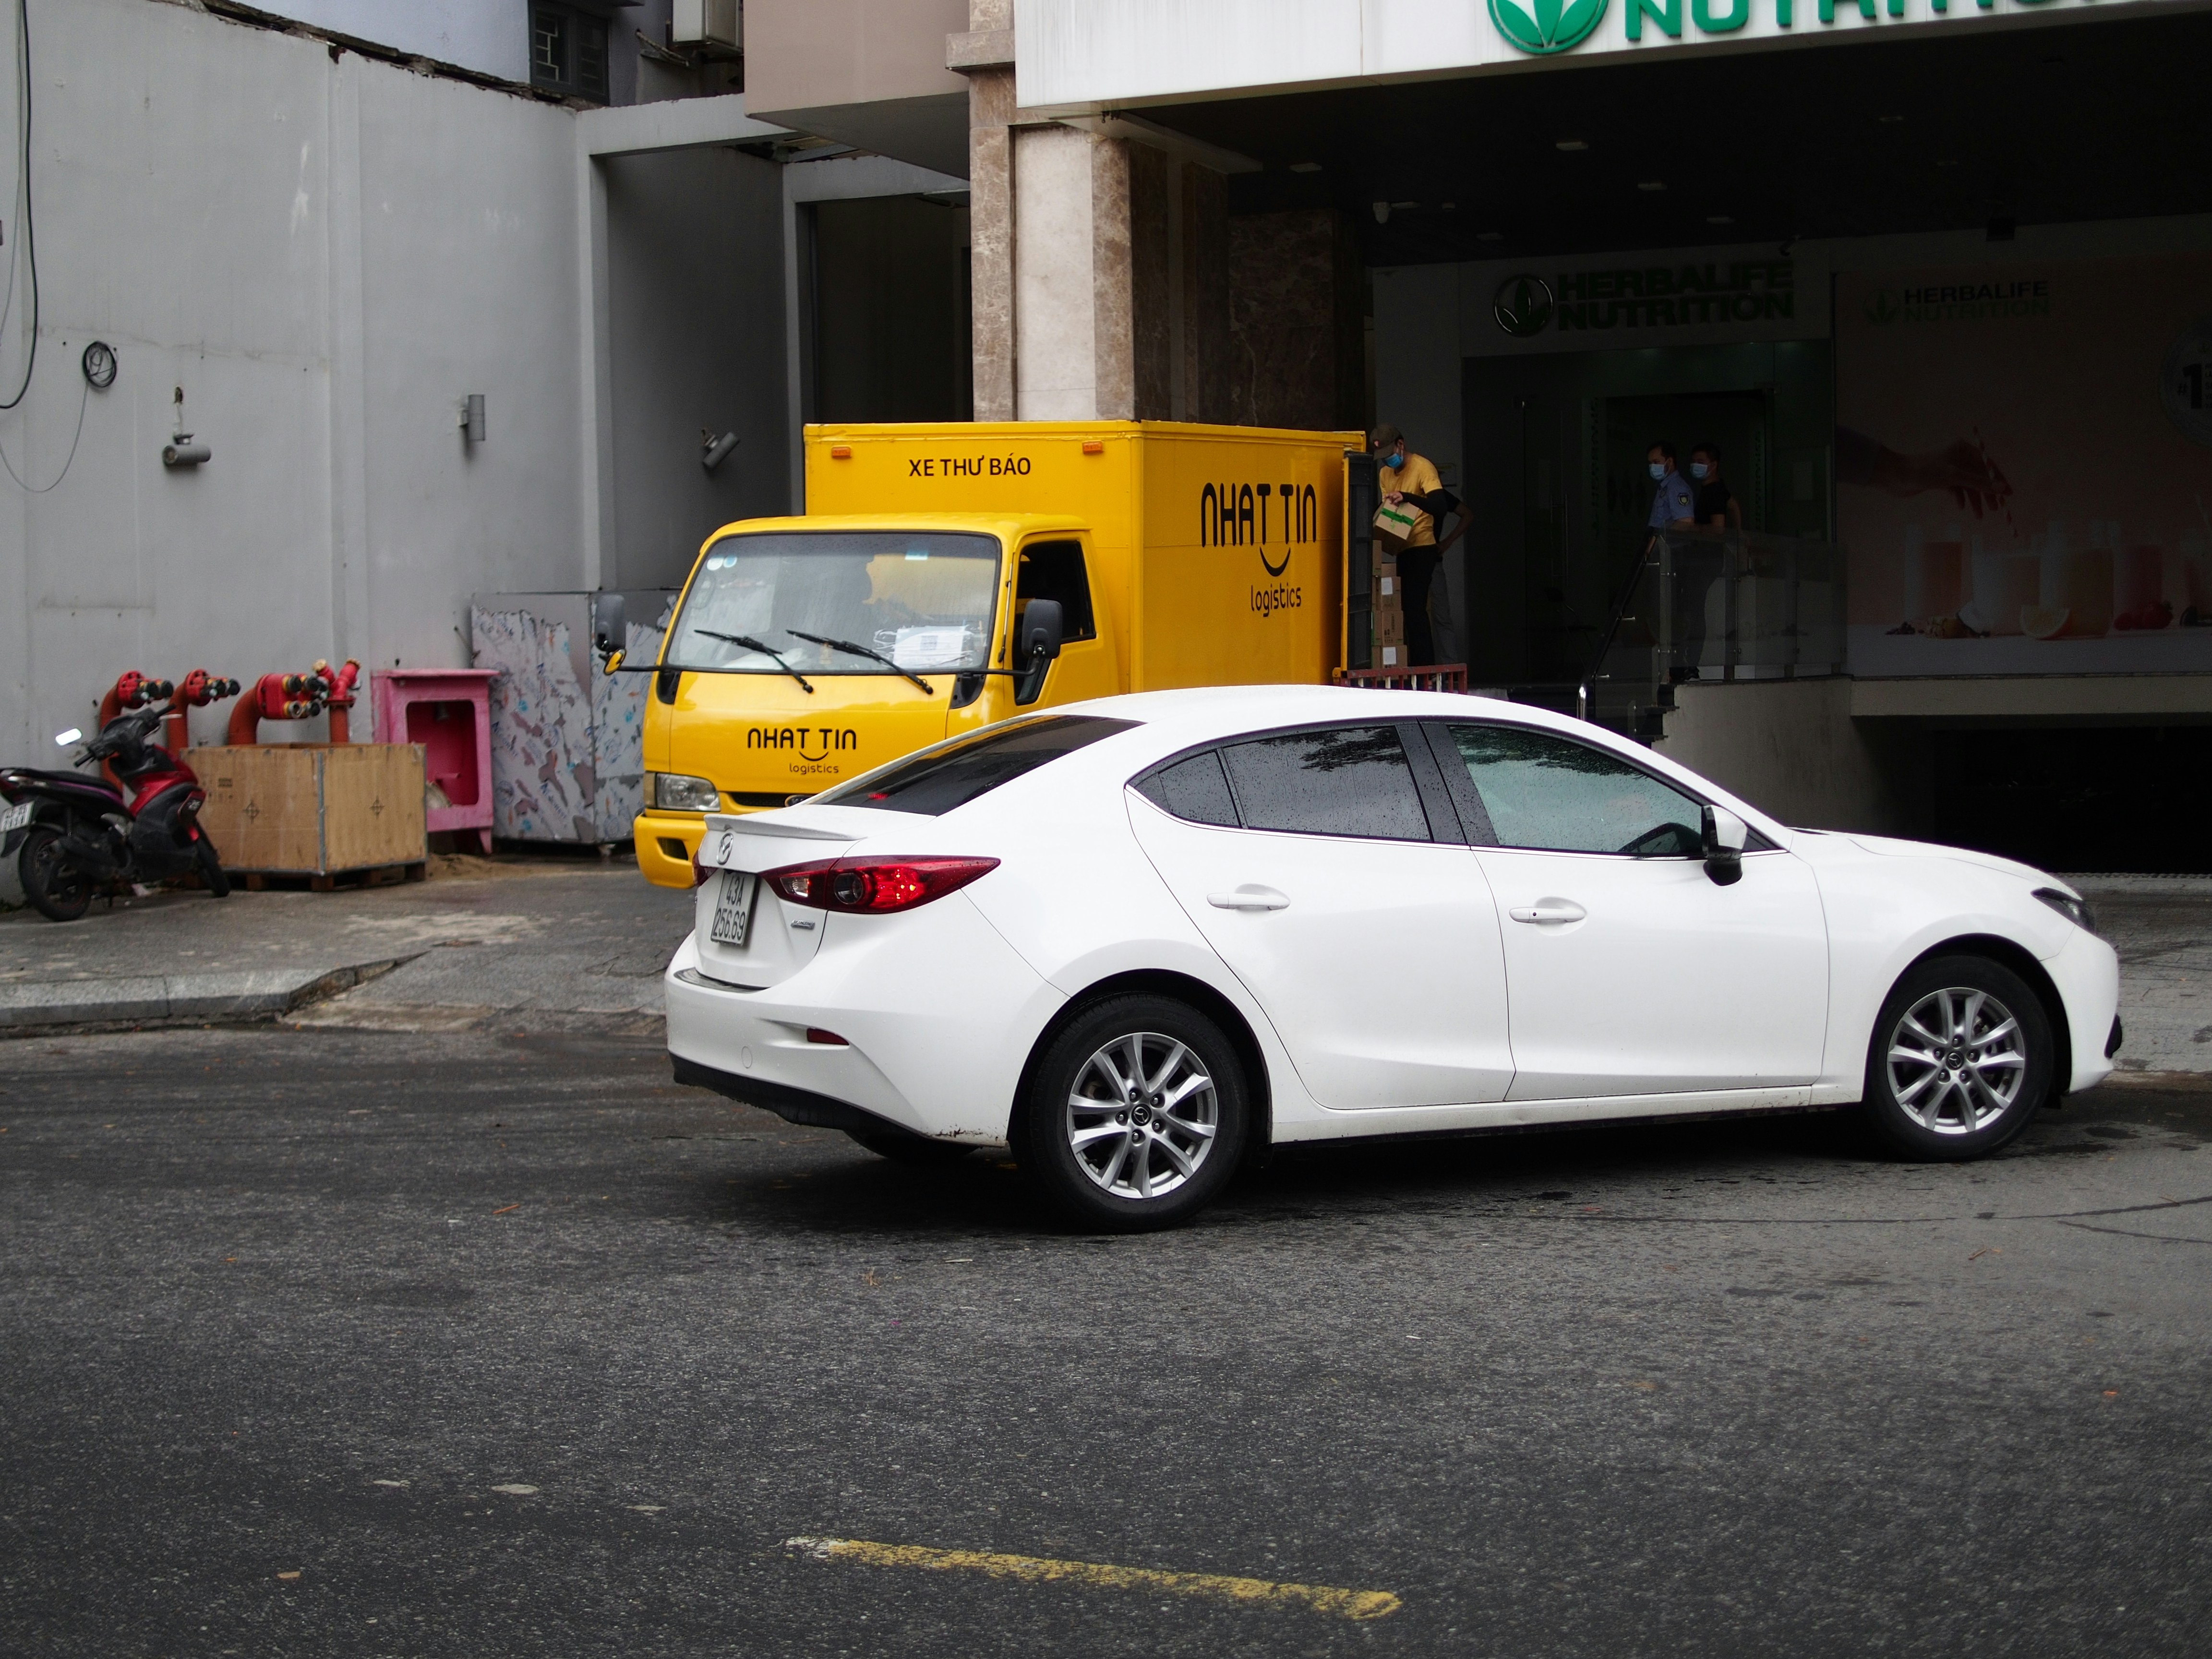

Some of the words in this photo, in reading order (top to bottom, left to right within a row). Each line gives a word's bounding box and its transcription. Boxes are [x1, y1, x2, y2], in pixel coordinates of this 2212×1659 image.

[1557, 260, 1794, 301] HERBALIFE
[1904, 281, 2048, 304] HERBALIFE
[1557, 291, 1794, 330] NUTRITION
[1904, 299, 2049, 322] NUTRITION
[909, 459, 934, 476] XE
[939, 455, 985, 476] THƯ
[989, 453, 1031, 475] BÁO
[1201, 482, 1271, 548] NHAT
[1250, 582, 1301, 617] logistics
[747, 728, 810, 749] NHAT
[789, 763, 839, 775] logistics
[726, 876, 745, 907] 43A
[712, 908, 745, 941] 256.69
